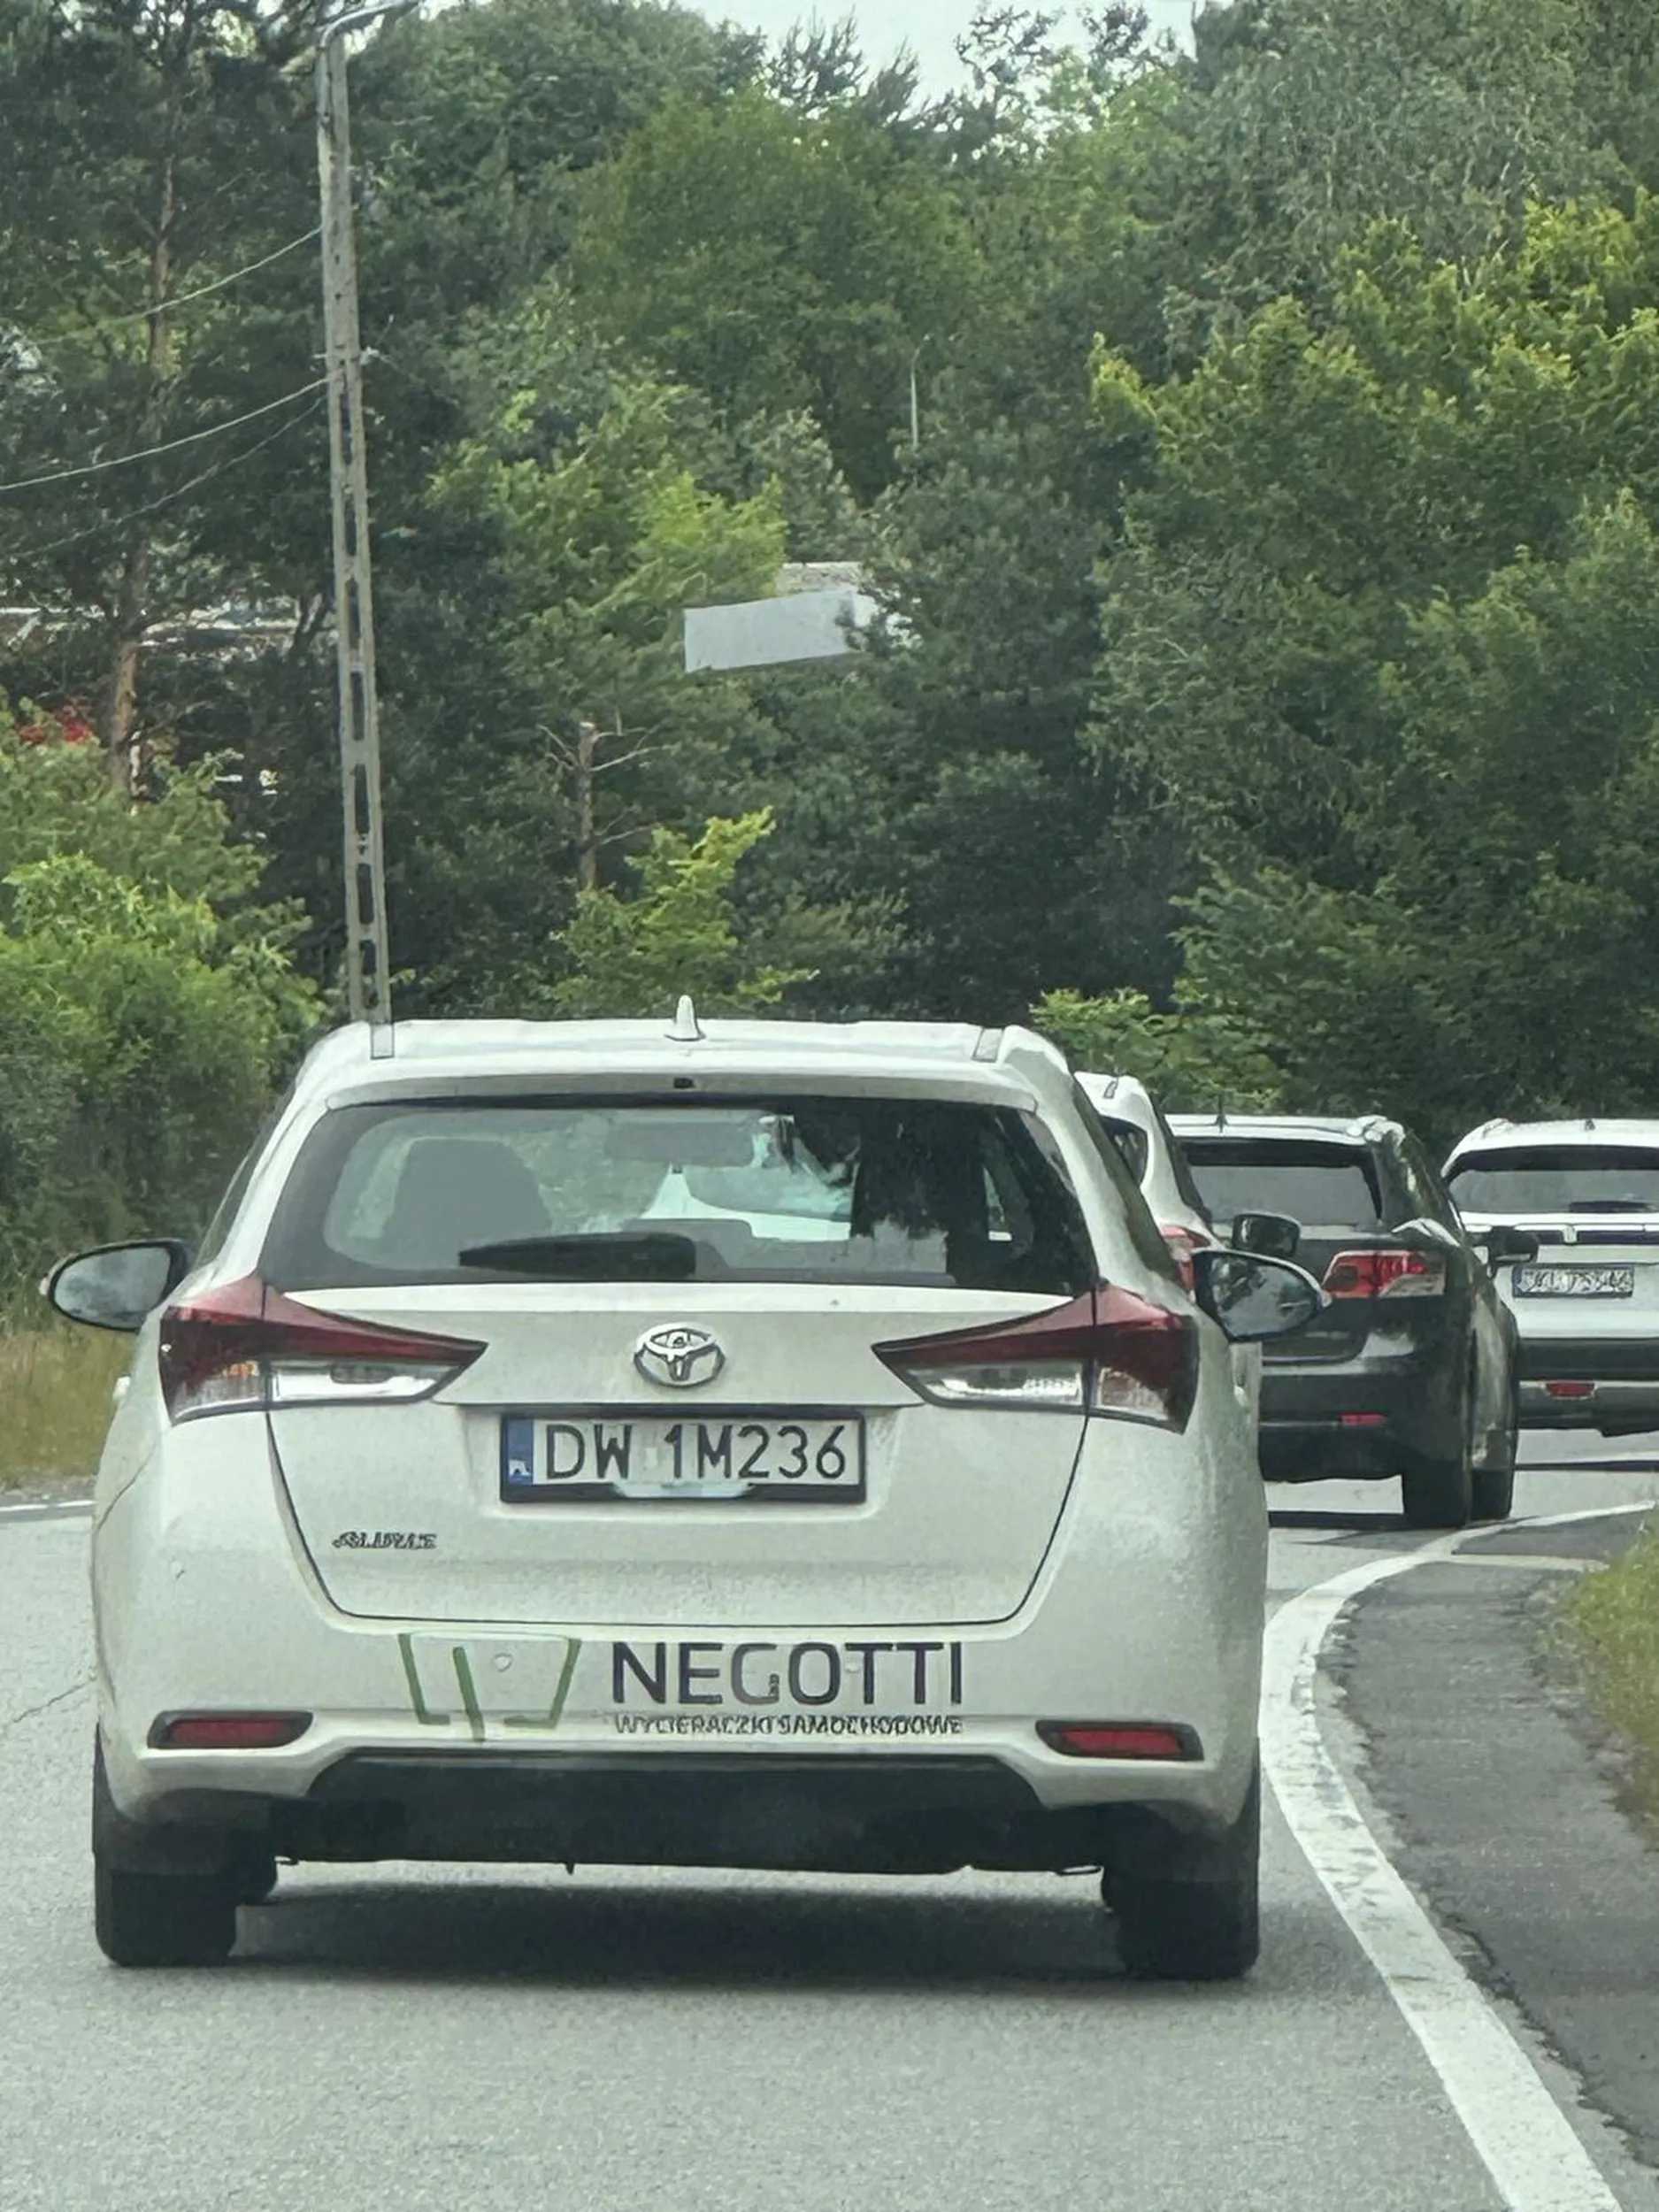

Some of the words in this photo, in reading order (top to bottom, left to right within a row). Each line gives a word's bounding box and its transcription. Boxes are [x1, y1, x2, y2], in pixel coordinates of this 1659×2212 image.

[547, 1424, 632, 1479] DW
[664, 1424, 846, 1479] 1M236
[612, 1641, 963, 1706] NEGOTTI
